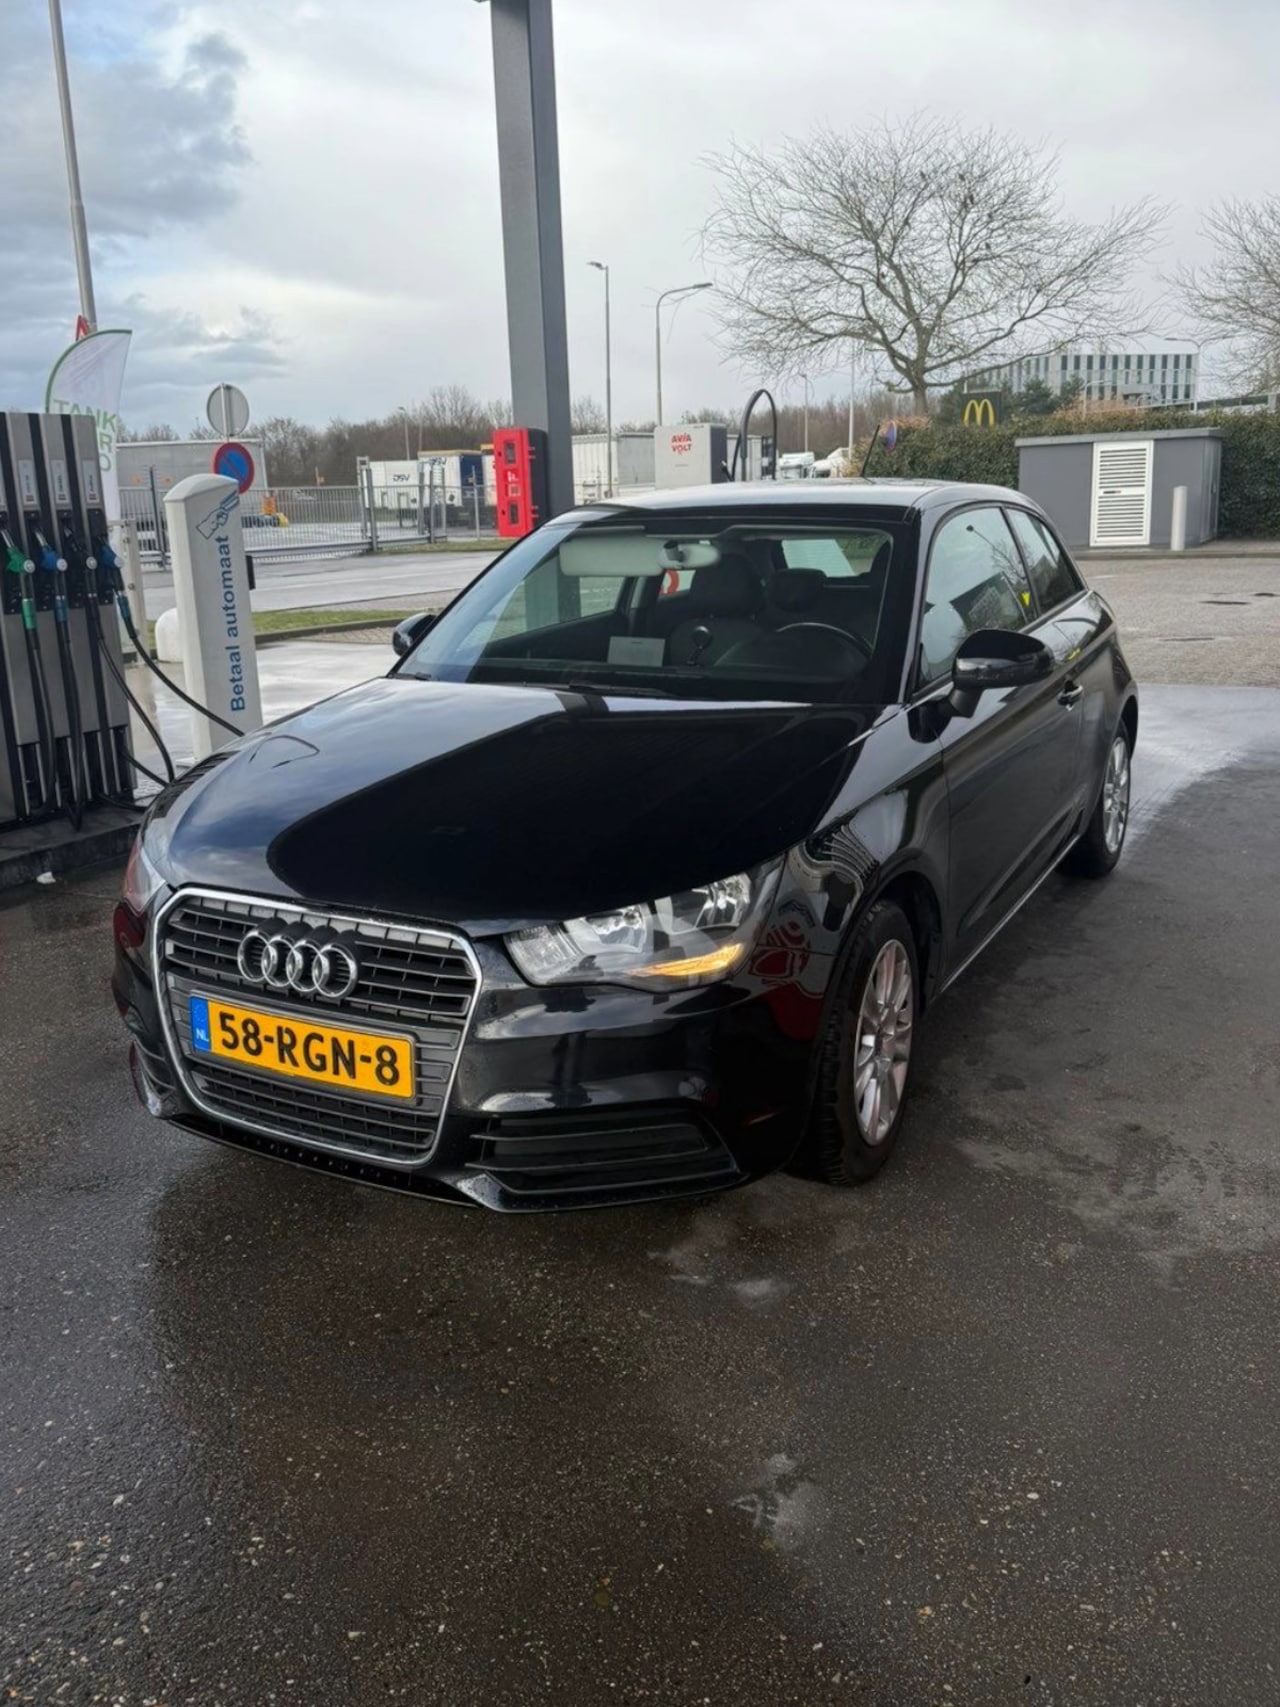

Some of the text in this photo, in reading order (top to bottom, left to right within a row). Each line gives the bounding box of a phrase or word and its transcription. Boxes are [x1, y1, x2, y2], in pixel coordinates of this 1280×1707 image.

[671, 432, 692, 443] AVIA
[671, 443, 692, 455] VOLT
[215, 535, 246, 711] Betaal automaat
[194, 1028, 210, 1043] NL
[218, 1011, 400, 1087] 58-RGN-8
